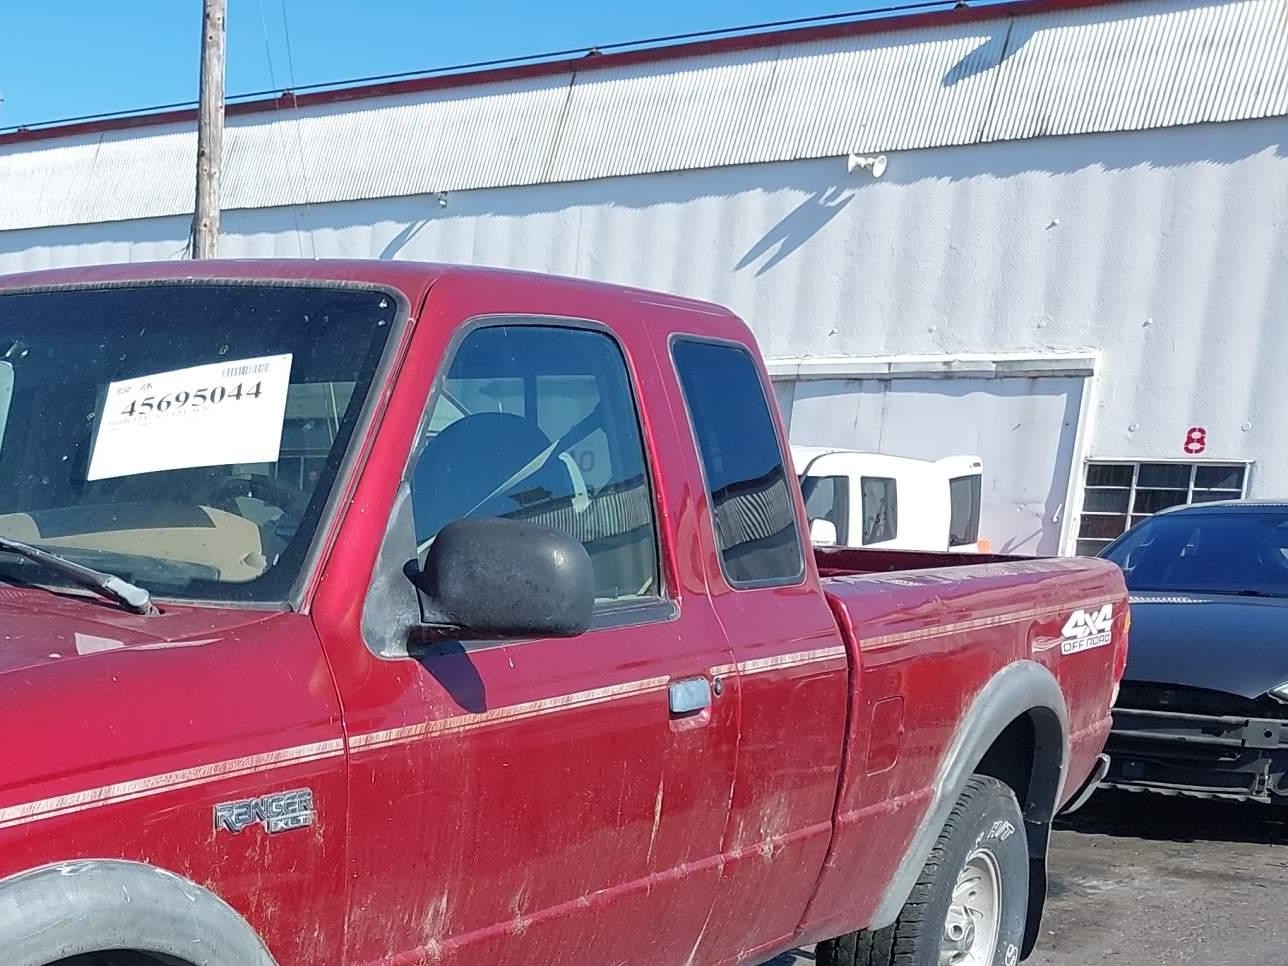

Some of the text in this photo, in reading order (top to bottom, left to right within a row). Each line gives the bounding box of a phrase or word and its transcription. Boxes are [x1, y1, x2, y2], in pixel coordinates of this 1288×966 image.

[121, 381, 262, 416] 45695044
[1184, 427, 1206, 454] 8
[1063, 633, 1110, 653] OFF ROAD
[214, 788, 313, 832] RANGER
